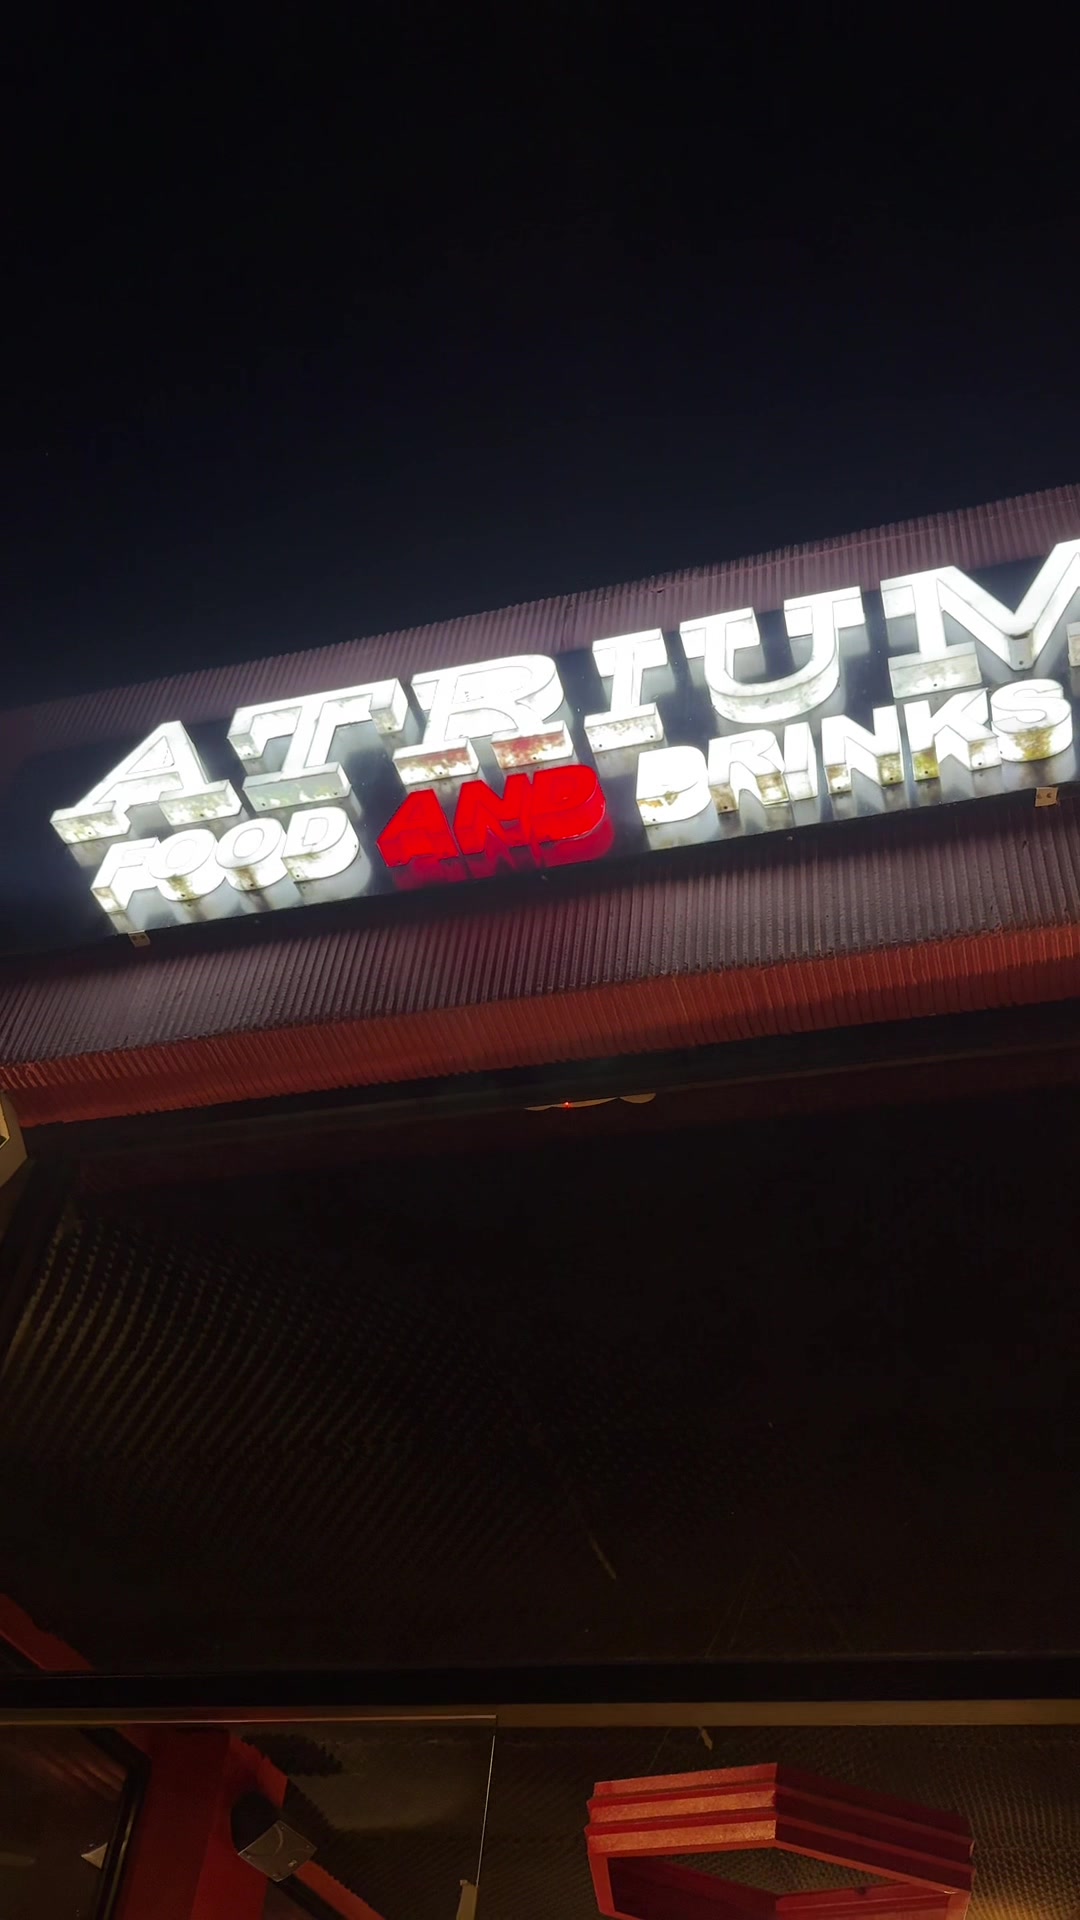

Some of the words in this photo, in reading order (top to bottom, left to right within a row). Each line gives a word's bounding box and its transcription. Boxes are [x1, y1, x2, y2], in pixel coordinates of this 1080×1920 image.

[50, 538, 1080, 840] ATRIUM
[91, 807, 359, 912] FOOD
[376, 765, 606, 867] AND
[636, 679, 1073, 827] DRINKS
